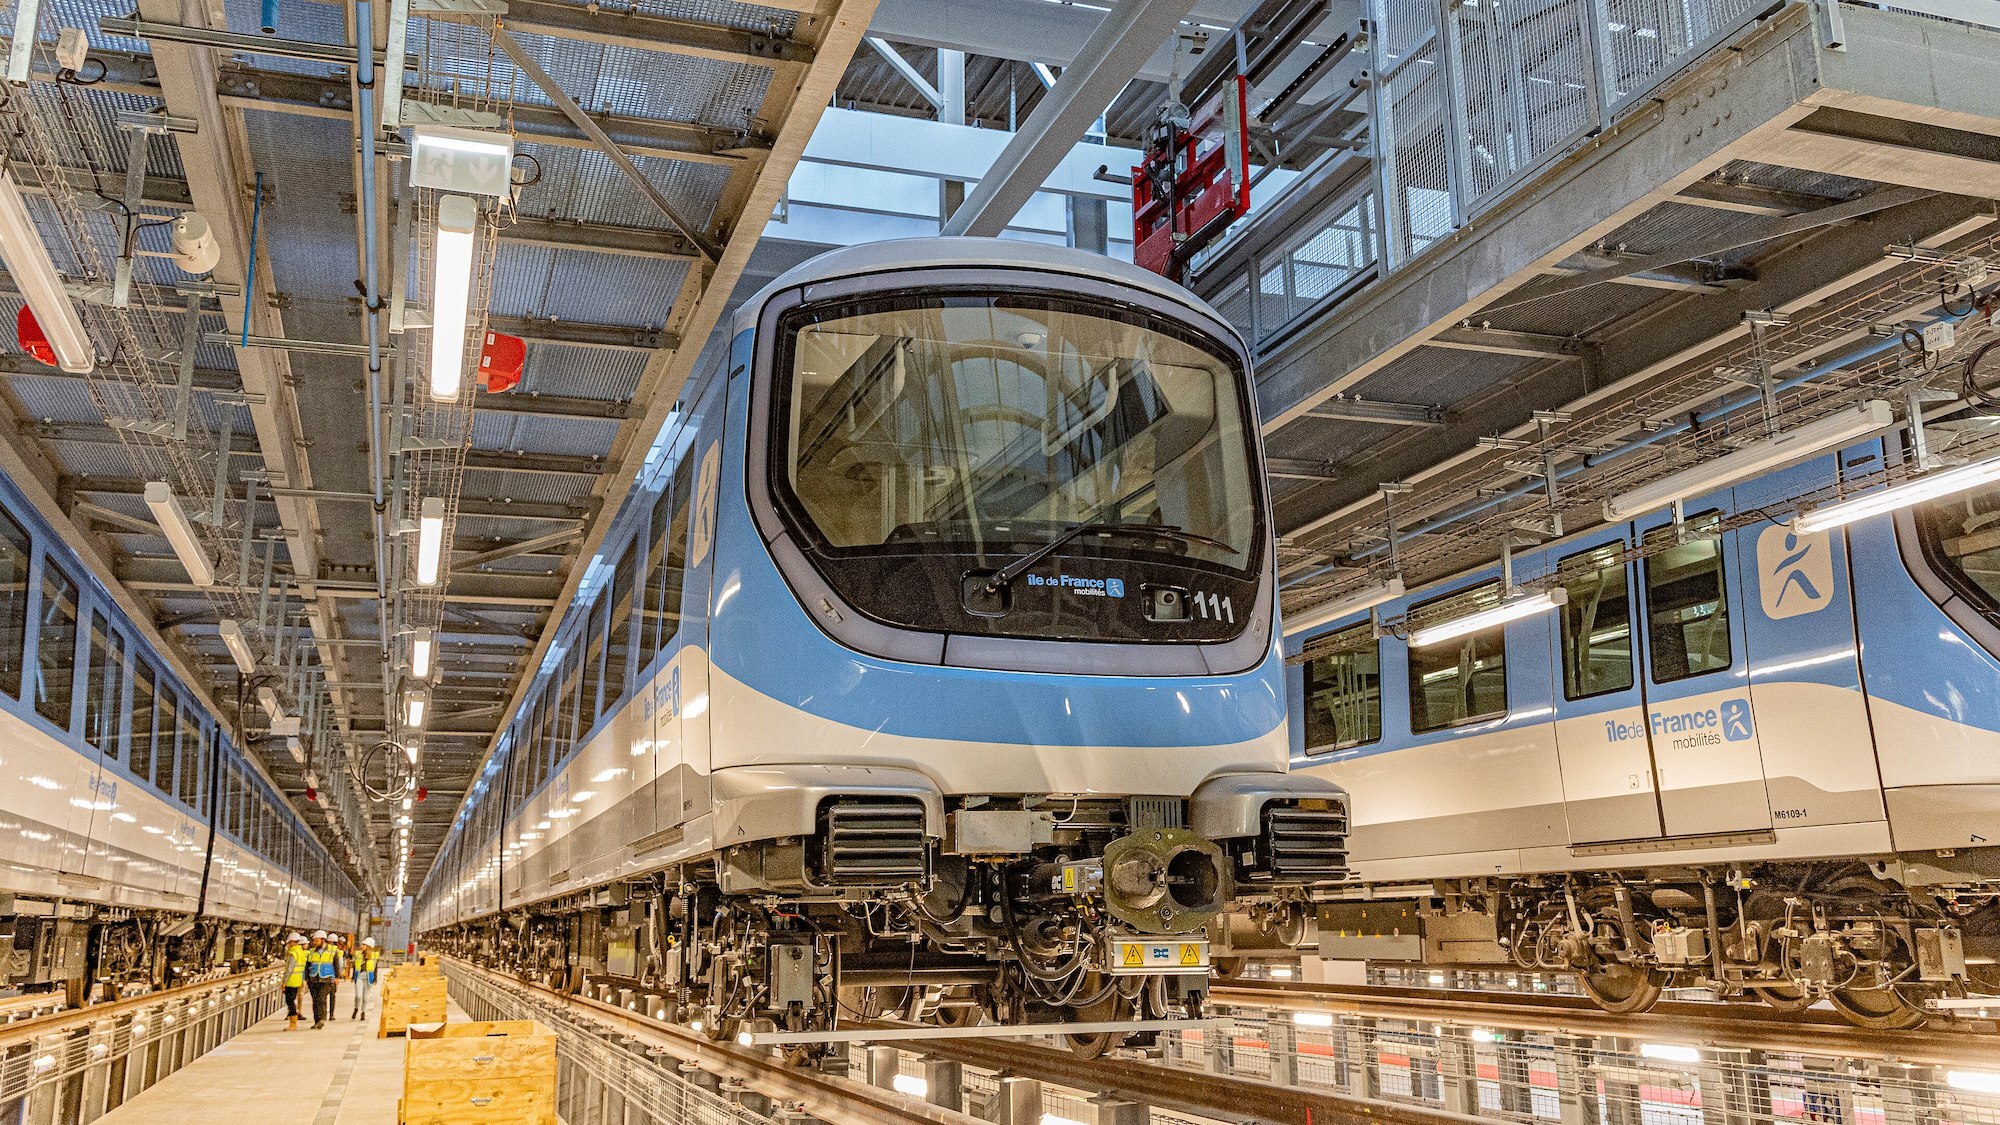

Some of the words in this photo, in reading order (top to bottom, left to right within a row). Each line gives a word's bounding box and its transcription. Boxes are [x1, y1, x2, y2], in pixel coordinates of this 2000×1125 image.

[1046, 576, 1058, 586] de
[1060, 575, 1105, 589] France
[1074, 587, 1106, 597] mobilités
[1193, 591, 1235, 624] 111
[1649, 709, 1718, 736] France
[1672, 730, 1721, 750] mobilités
[1774, 808, 1807, 819] M6109-1
